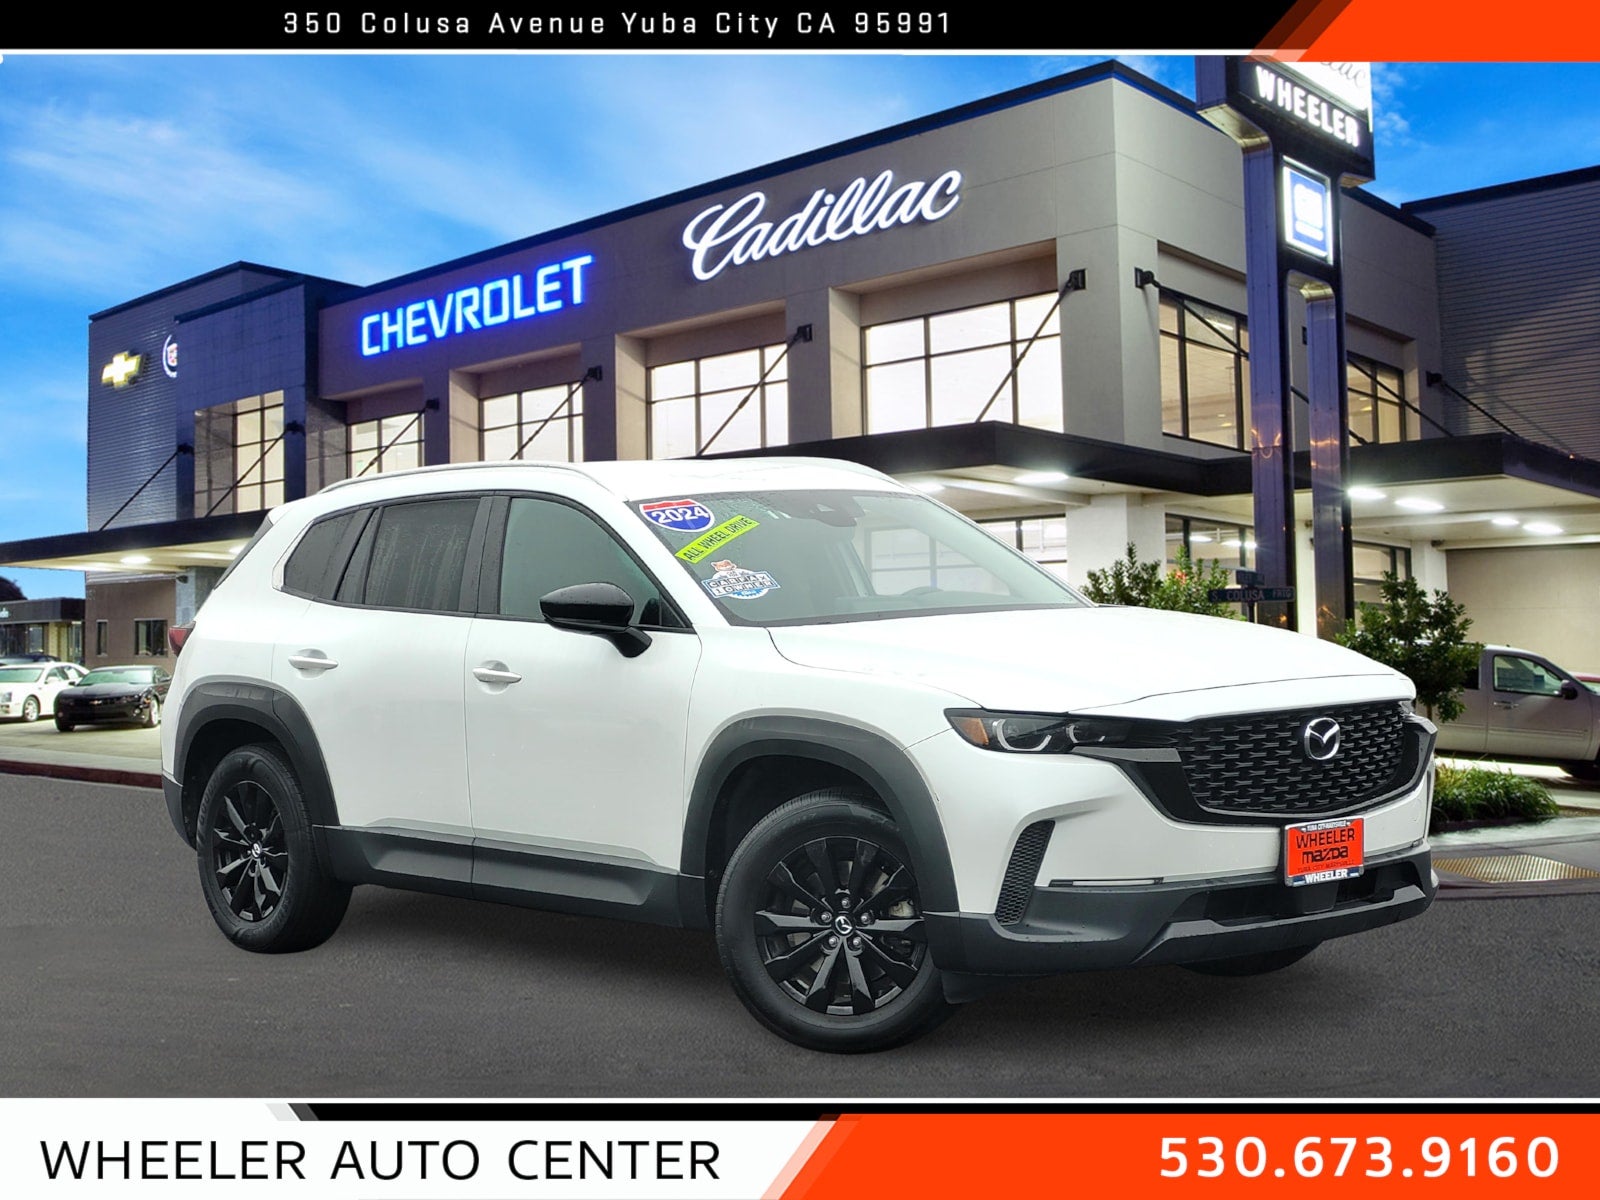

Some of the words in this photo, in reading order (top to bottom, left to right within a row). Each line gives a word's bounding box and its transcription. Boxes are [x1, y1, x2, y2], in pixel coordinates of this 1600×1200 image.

[1255, 65, 1360, 147] WHEELER
[682, 169, 962, 281] Cadillac
[361, 255, 593, 357] CHEVROLET
[651, 506, 710, 524] 2024
[683, 546, 702, 561] ALL
[699, 530, 730, 551] WHEEL
[728, 516, 754, 537] DRIVE
[708, 573, 770, 588] CARFAX
[1226, 589, 1265, 601] COLUSA
[1296, 828, 1355, 849] WHEELER
[1302, 846, 1349, 864] mazda
[1304, 869, 1349, 884] WHEELER
